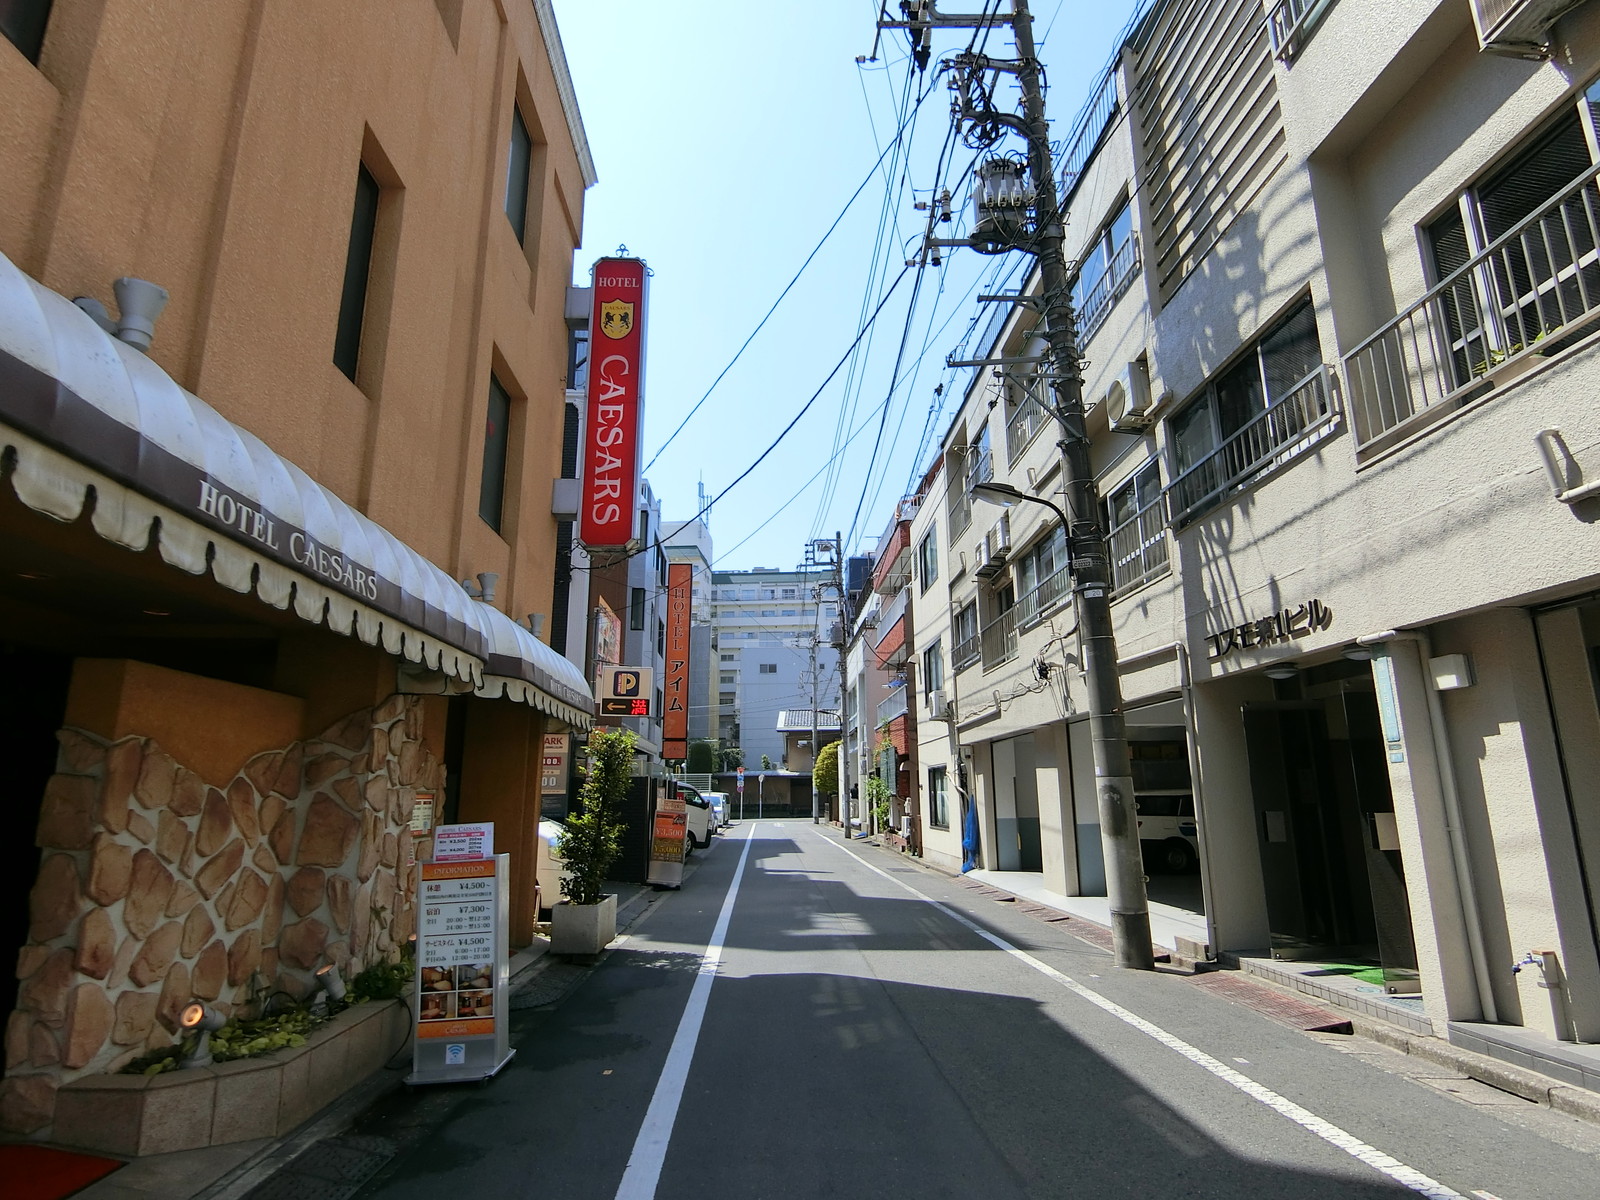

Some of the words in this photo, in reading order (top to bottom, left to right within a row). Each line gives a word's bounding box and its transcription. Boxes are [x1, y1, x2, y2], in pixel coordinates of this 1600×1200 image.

[598, 276, 640, 288] HOTEL
[592, 353, 630, 526] CAESARS
[196, 480, 279, 551] HOTEL
[289, 531, 378, 601] CAESARS
[672, 587, 686, 651] HOTEL
[1203, 598, 1332, 660] コスモ第1ビル
[620, 672, 637, 694] P
[668, 659, 686, 713] アイム
[631, 699, 647, 715] 満
[426, 884, 441, 892] 休憩
[433, 866, 485, 875] INFORMATION
